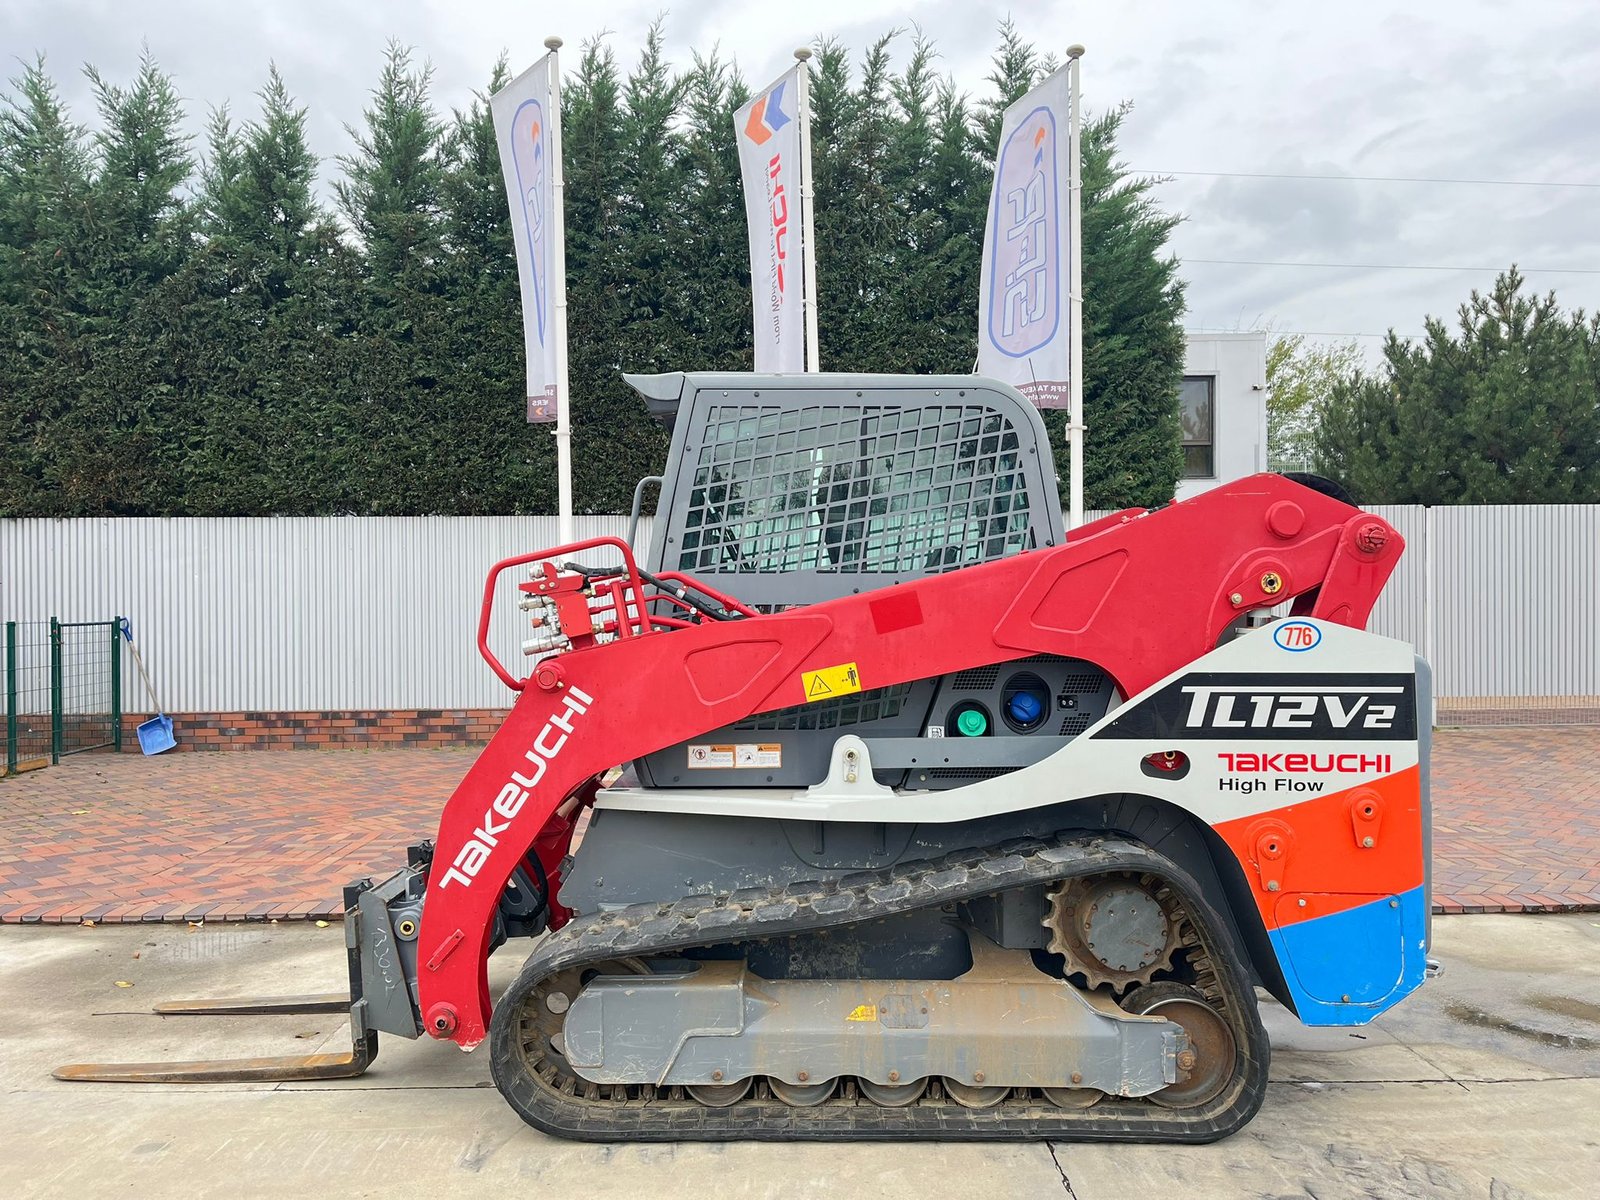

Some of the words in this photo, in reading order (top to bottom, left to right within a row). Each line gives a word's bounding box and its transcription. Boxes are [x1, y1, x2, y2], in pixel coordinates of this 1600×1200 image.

[1283, 627, 1313, 647] 776
[1218, 753, 1391, 773] TAKEUCHI
[439, 685, 594, 888] TAKEUCHI
[1218, 777, 1267, 794] High
[1274, 777, 1324, 792] Flow
